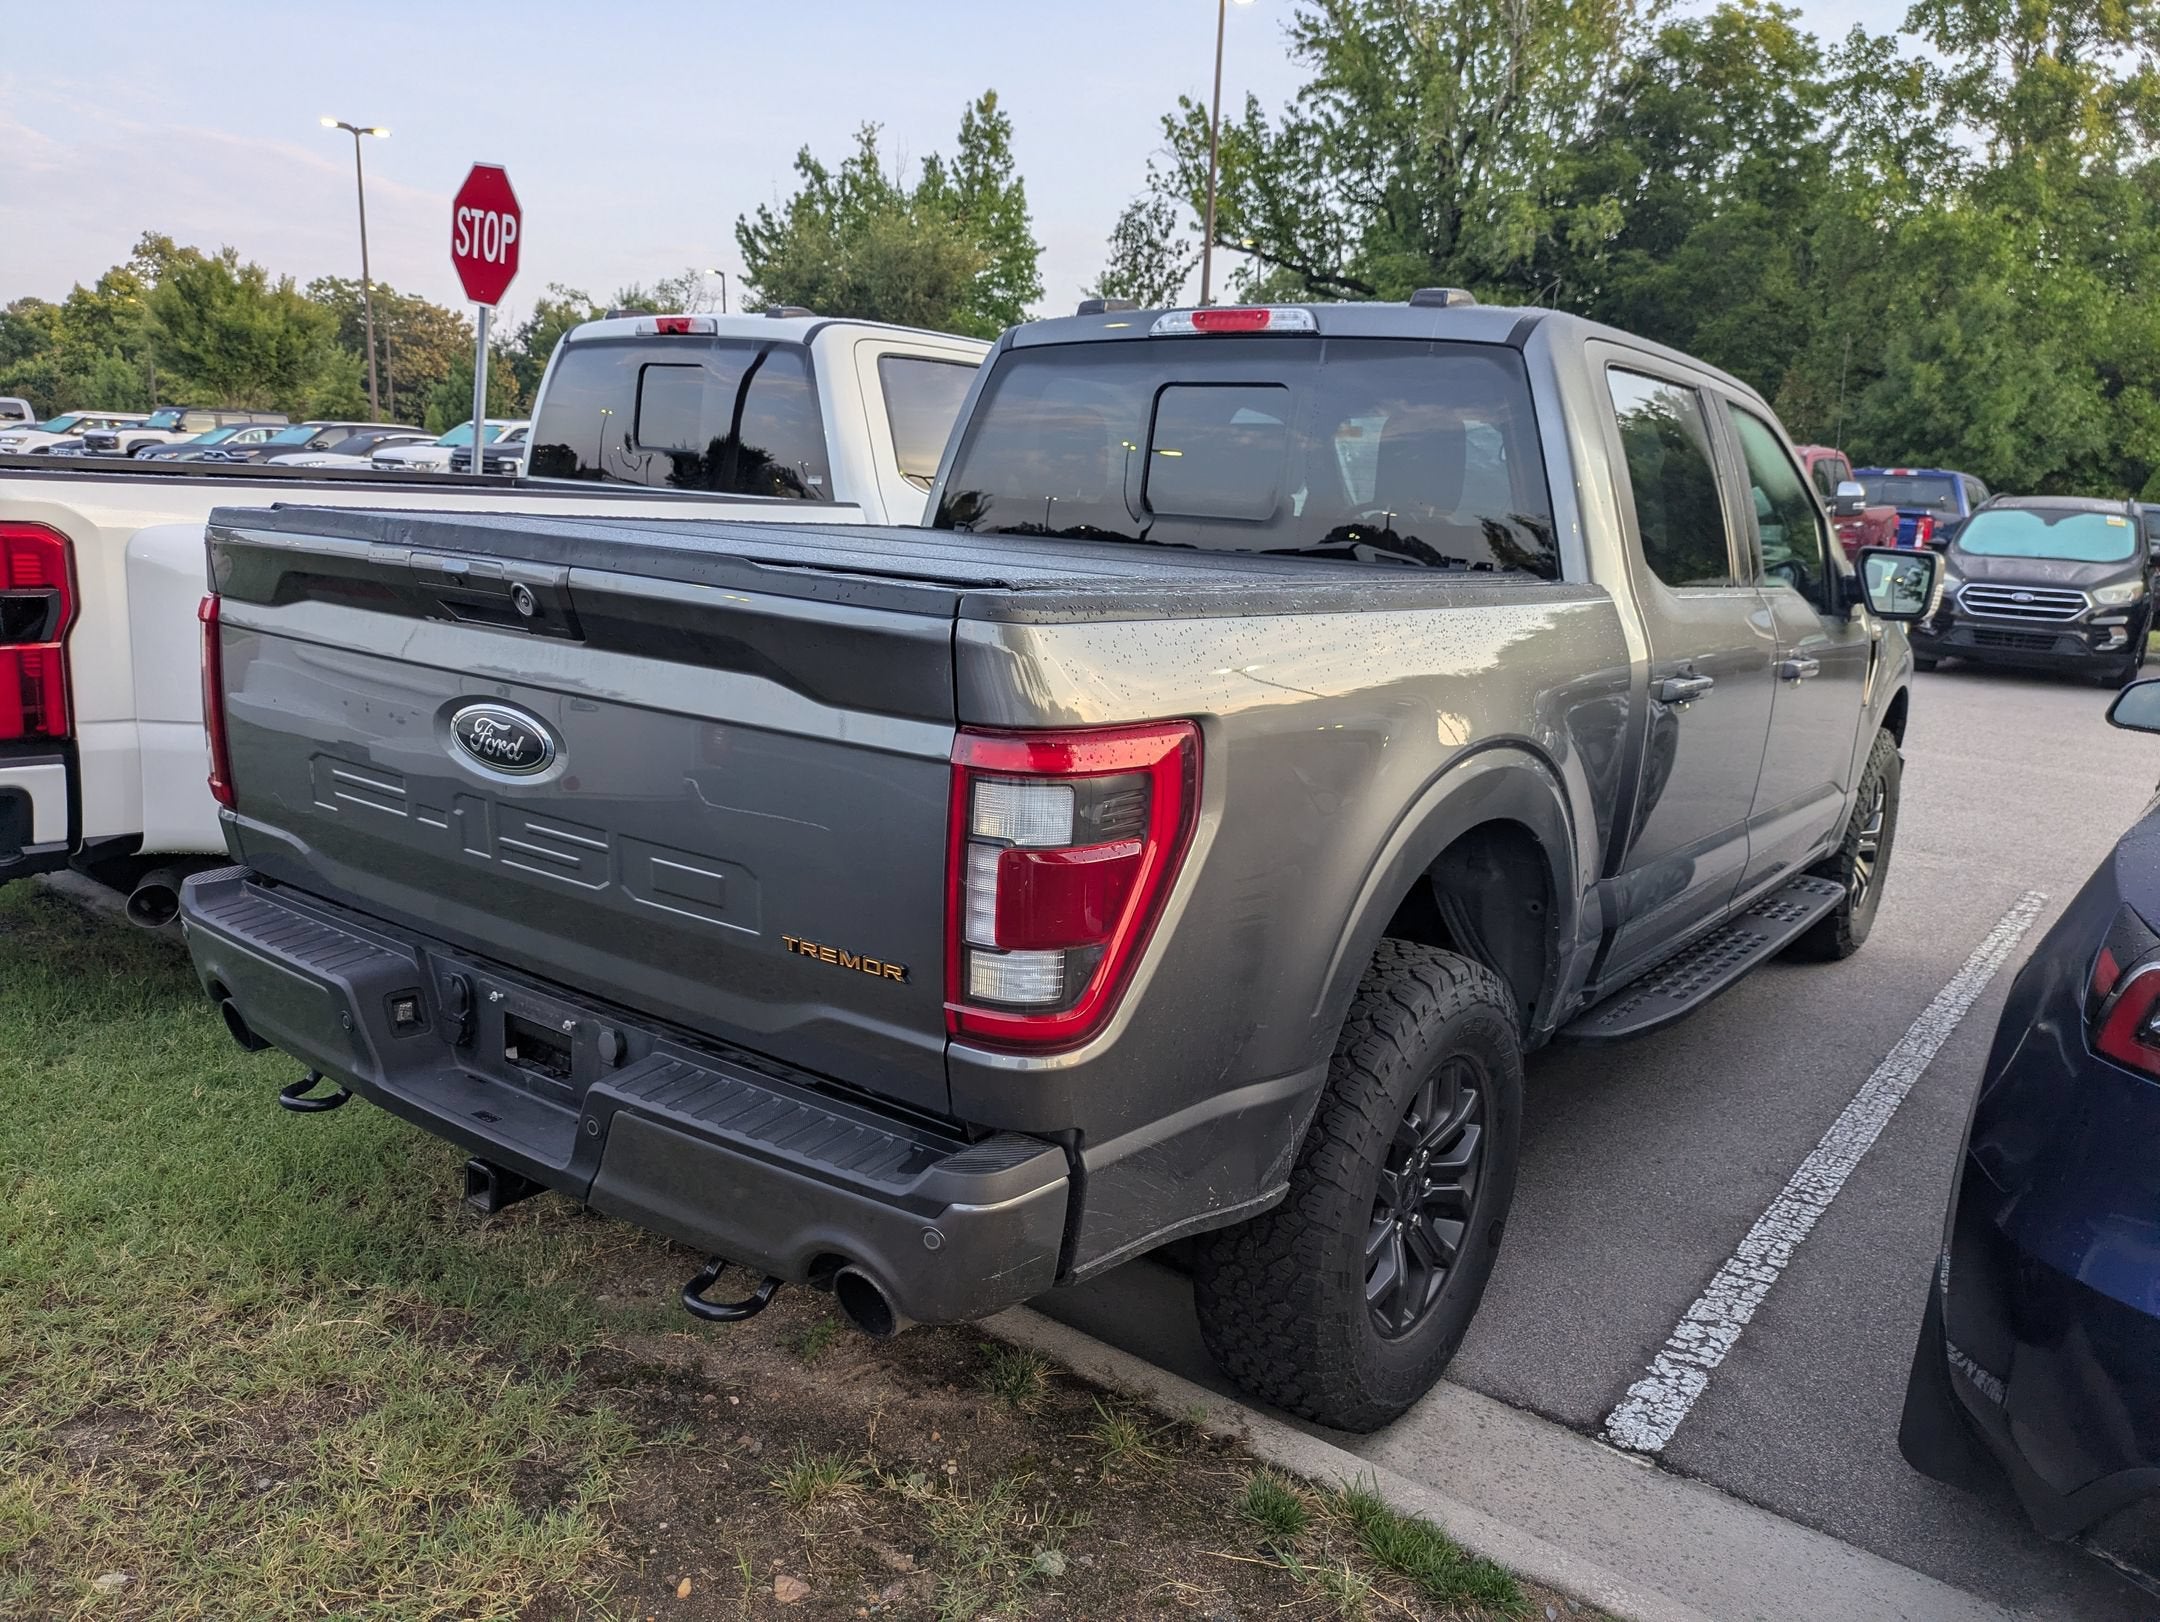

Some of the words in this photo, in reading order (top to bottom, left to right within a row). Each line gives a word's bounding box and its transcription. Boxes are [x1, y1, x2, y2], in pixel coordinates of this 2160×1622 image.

[455, 205, 517, 265] STOP
[469, 717, 524, 761] Ford
[308, 752, 761, 936] F-150
[780, 935, 907, 984] TREMOR
